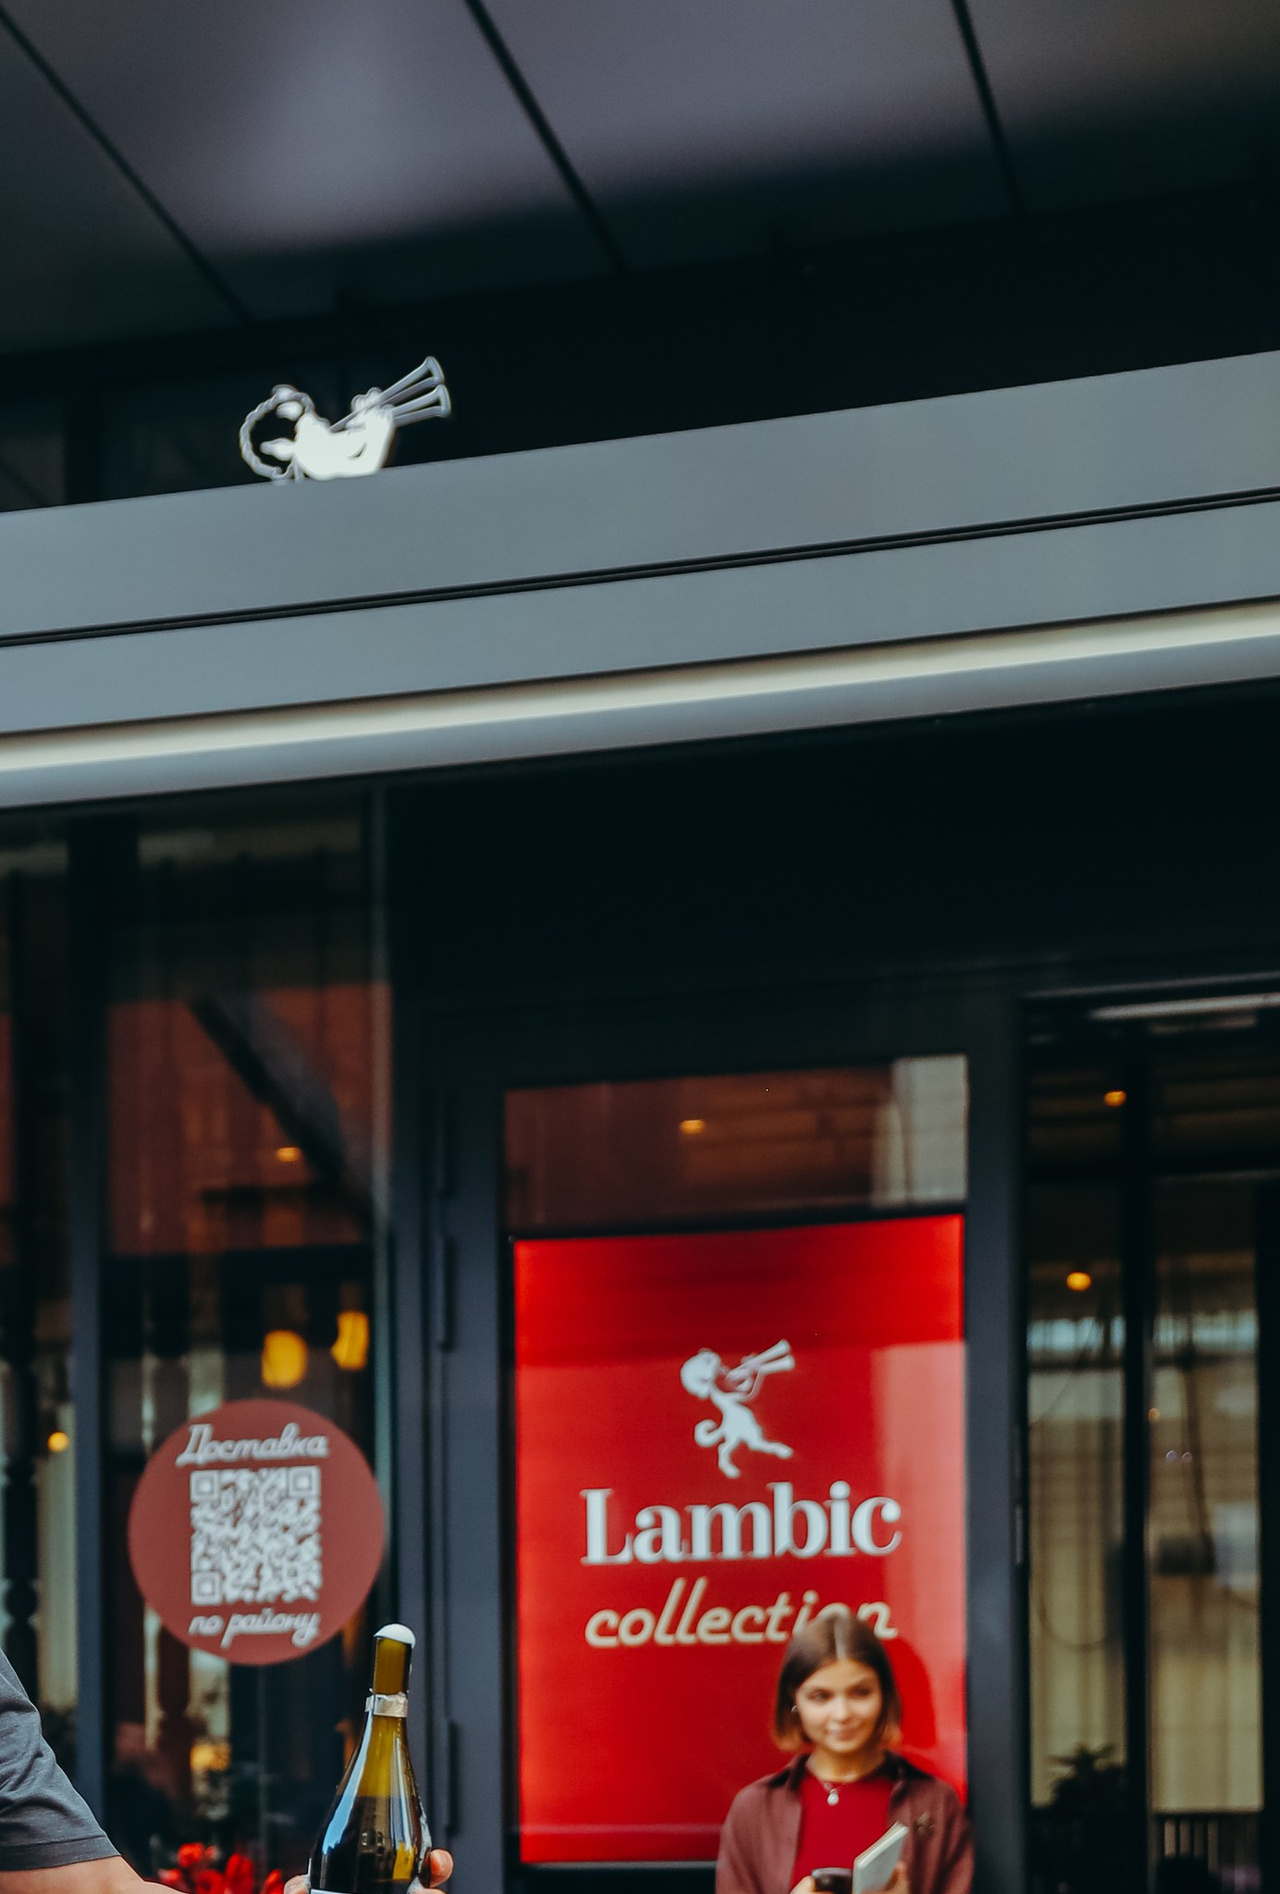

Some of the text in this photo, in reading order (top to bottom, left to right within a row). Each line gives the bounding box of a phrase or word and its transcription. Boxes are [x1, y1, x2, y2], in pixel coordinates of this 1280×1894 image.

[176, 1423, 328, 1466] Доставка
[581, 1480, 901, 1564] Lambic
[189, 1608, 320, 1647] по району
